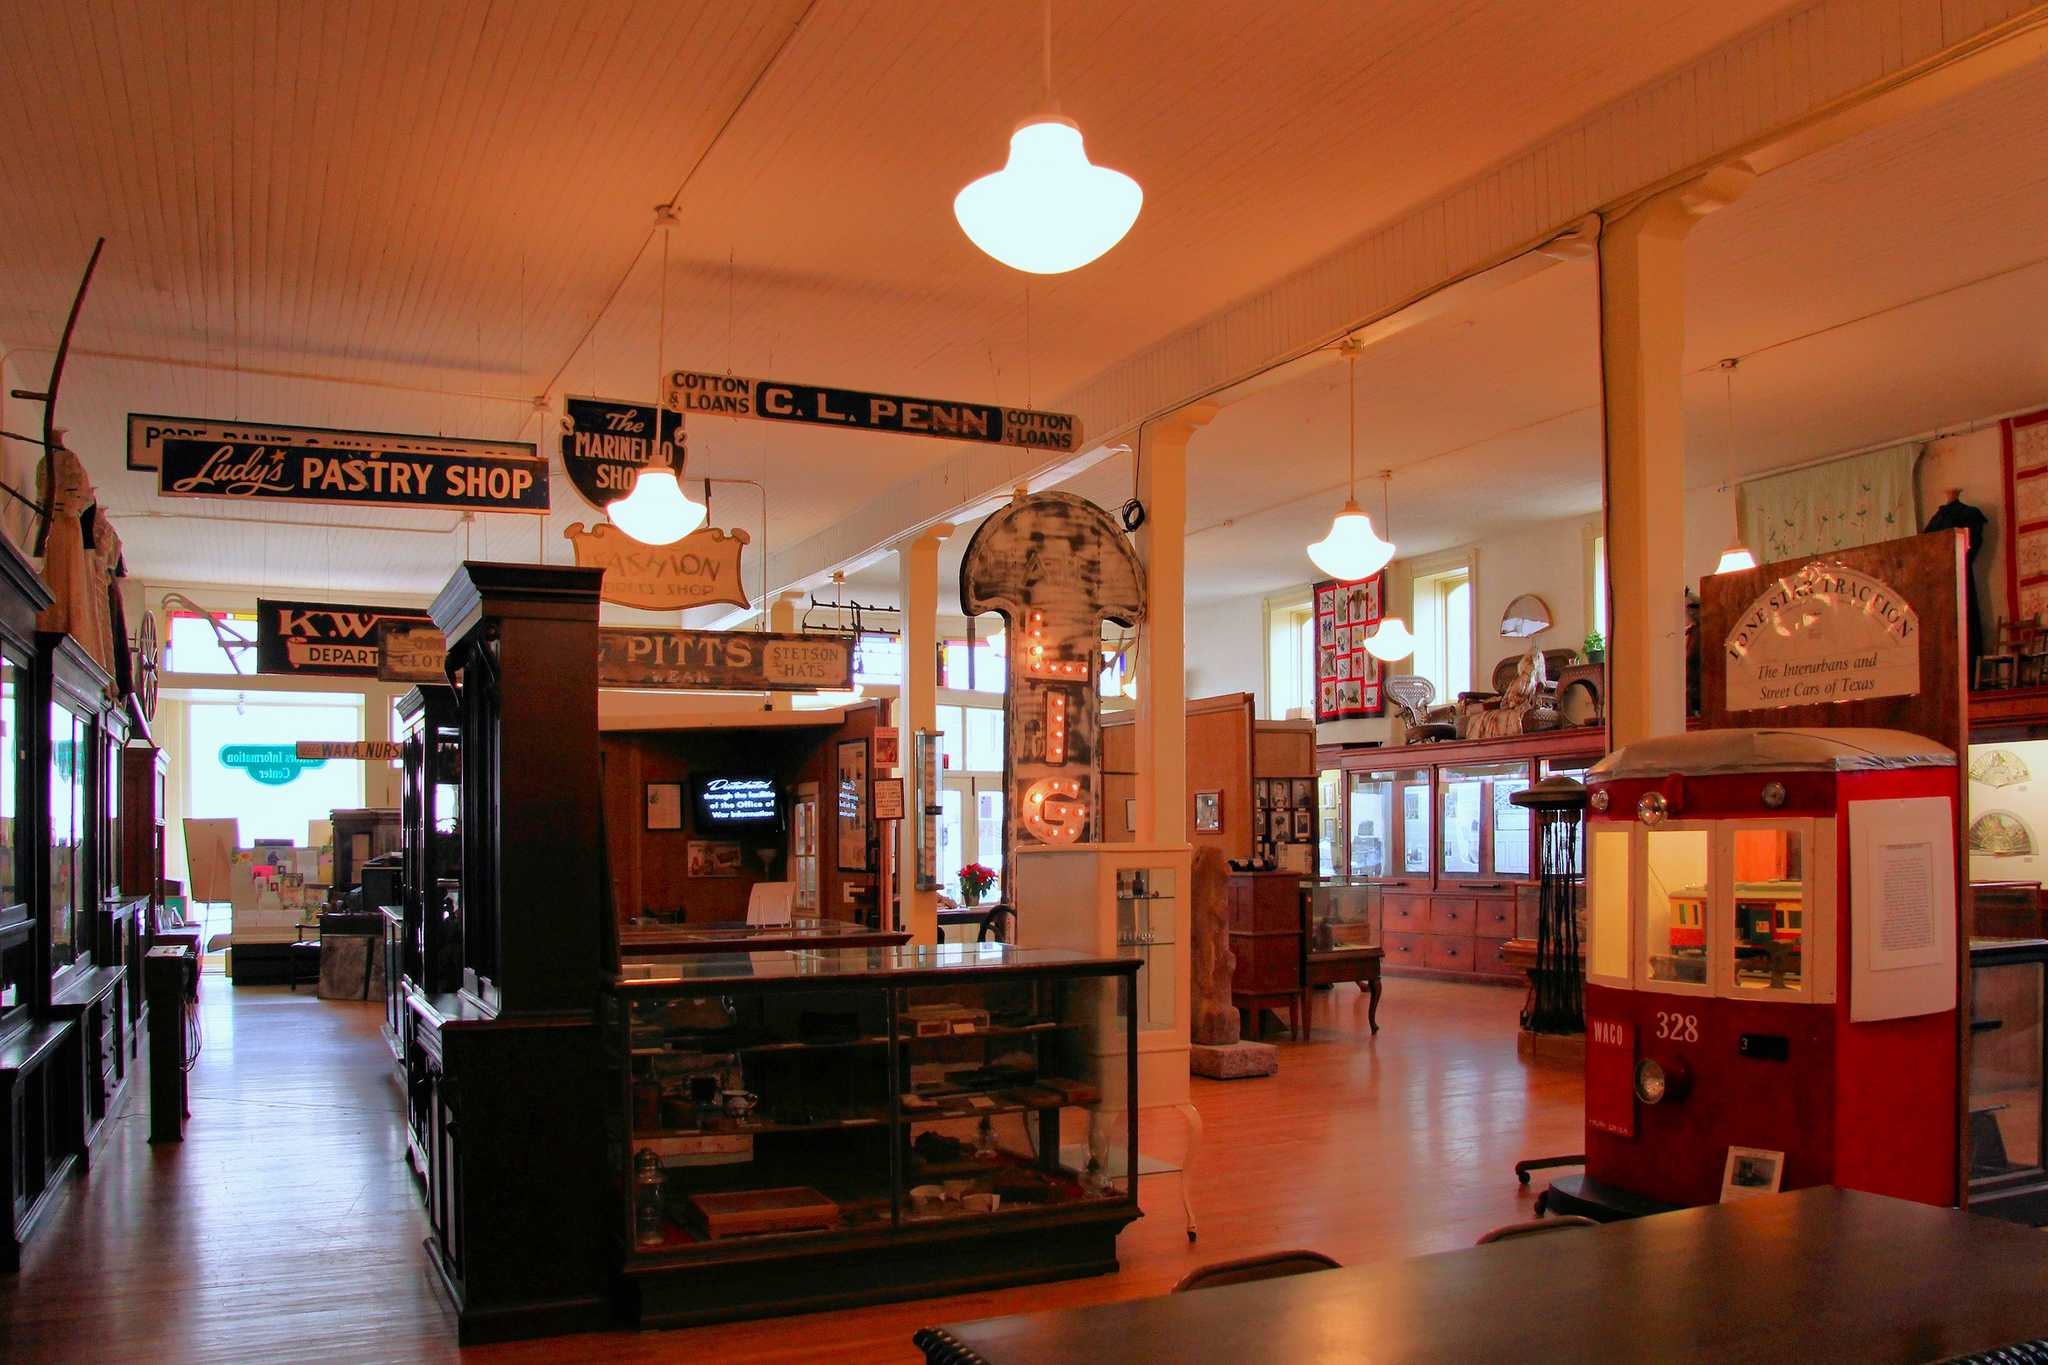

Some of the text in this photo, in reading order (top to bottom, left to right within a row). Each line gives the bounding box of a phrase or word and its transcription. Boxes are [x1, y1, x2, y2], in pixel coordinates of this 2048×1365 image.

[672, 372, 750, 394] COTTON
[686, 394, 750, 414] LOANS
[765, 388, 988, 436] C. L. PENN
[606, 408, 646, 433] The
[1007, 410, 1073, 431] COTTON
[1015, 428, 1072, 448] LOANS
[303, 457, 434, 495] PASTRY
[446, 465, 534, 500] SHOP
[596, 463, 640, 490] SHO
[1729, 607, 1769, 660] LONE
[309, 647, 379, 665] DEPART
[626, 635, 753, 668] PITTS
[773, 648, 839, 662] STETSON
[784, 664, 826, 679] HATS
[1758, 652, 1878, 680] The Interurbans and
[1760, 678, 1875, 700] Street Cars of Texas
[710, 799, 775, 809] of the Office of
[734, 791, 747, 799] the
[712, 811, 730, 819] War
[1593, 1021, 1624, 1047] WACO
[1656, 1011, 1699, 1043] 328
